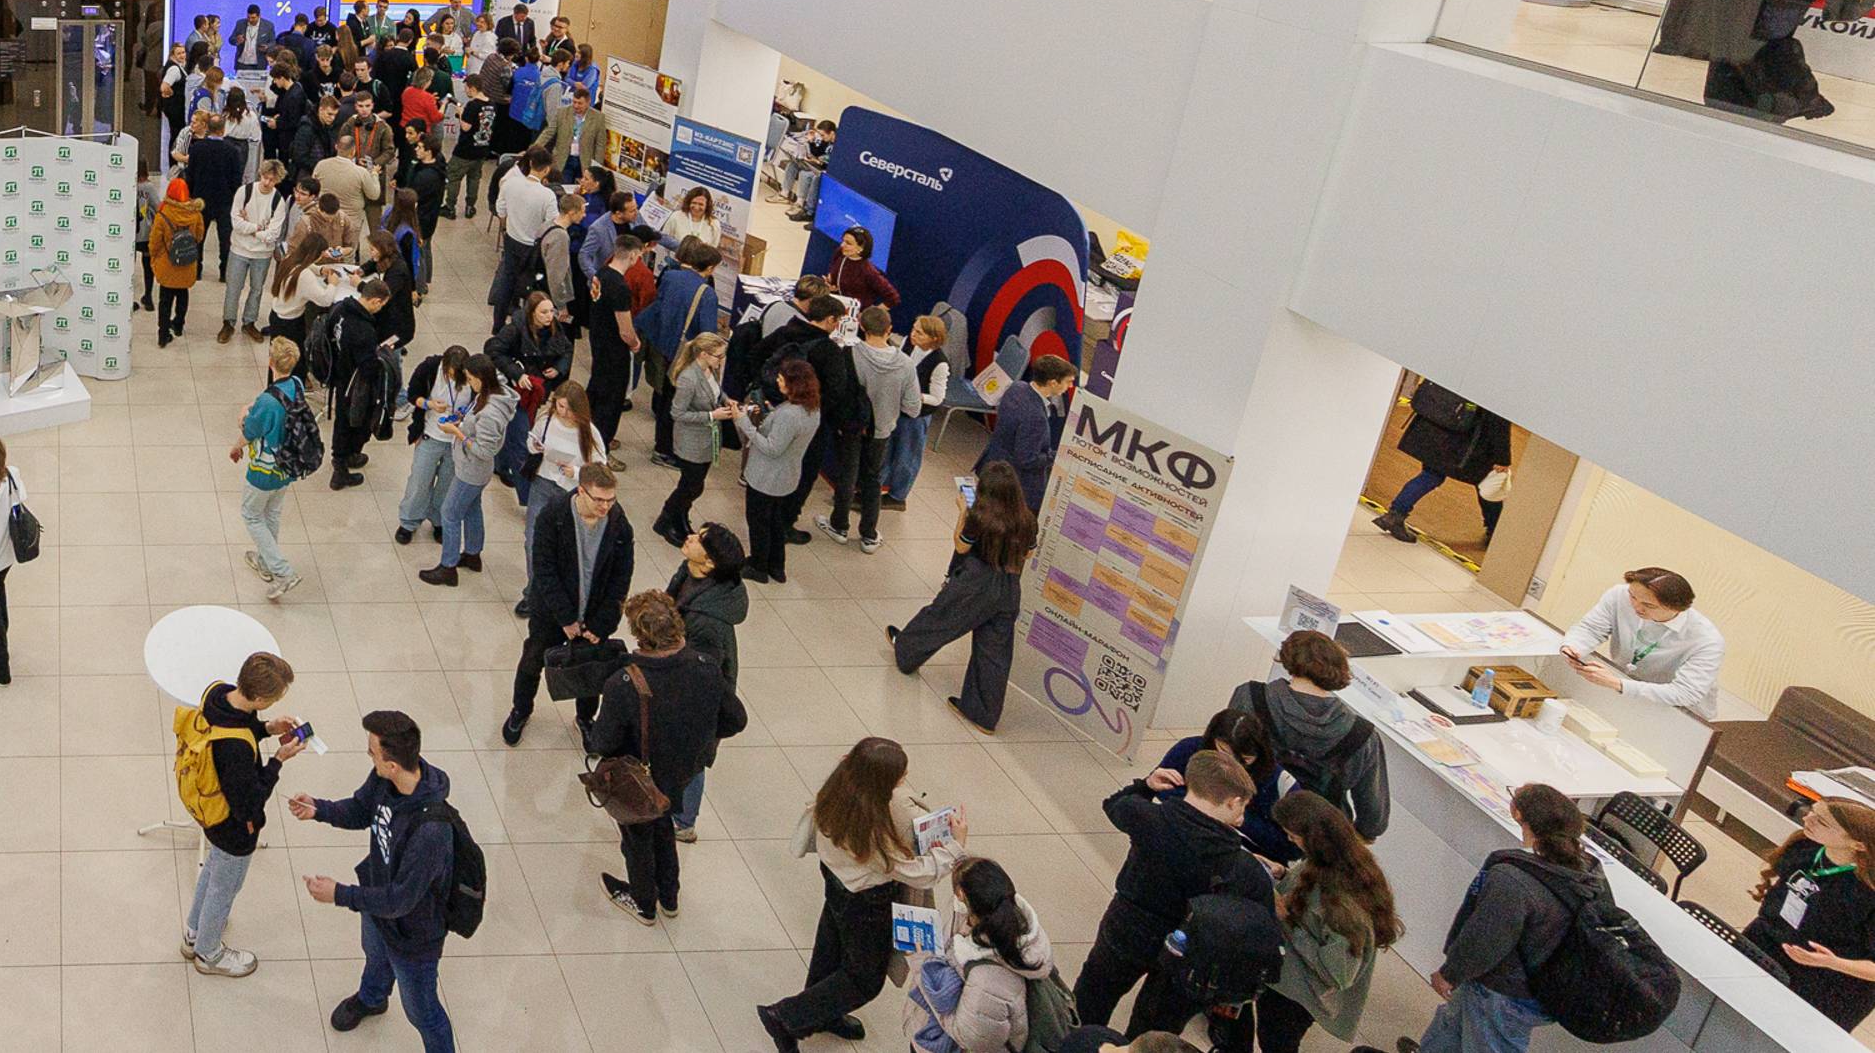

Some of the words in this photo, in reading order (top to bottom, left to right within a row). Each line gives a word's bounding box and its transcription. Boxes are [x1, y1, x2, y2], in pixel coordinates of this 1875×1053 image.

[859, 150, 944, 192] Северсталь
[1072, 435, 1108, 459] ПОТОК
[1111, 455, 1209, 508] ВОЗМОЖНОСТЕЙ
[1075, 404, 1217, 490] МКФ
[1067, 449, 1128, 484] РАСПИСАНИЕ
[1131, 481, 1204, 522] АКТИВНОСТЕЙ
[1044, 606, 1130, 662] ОНЛАЙН-МАРАФОН
